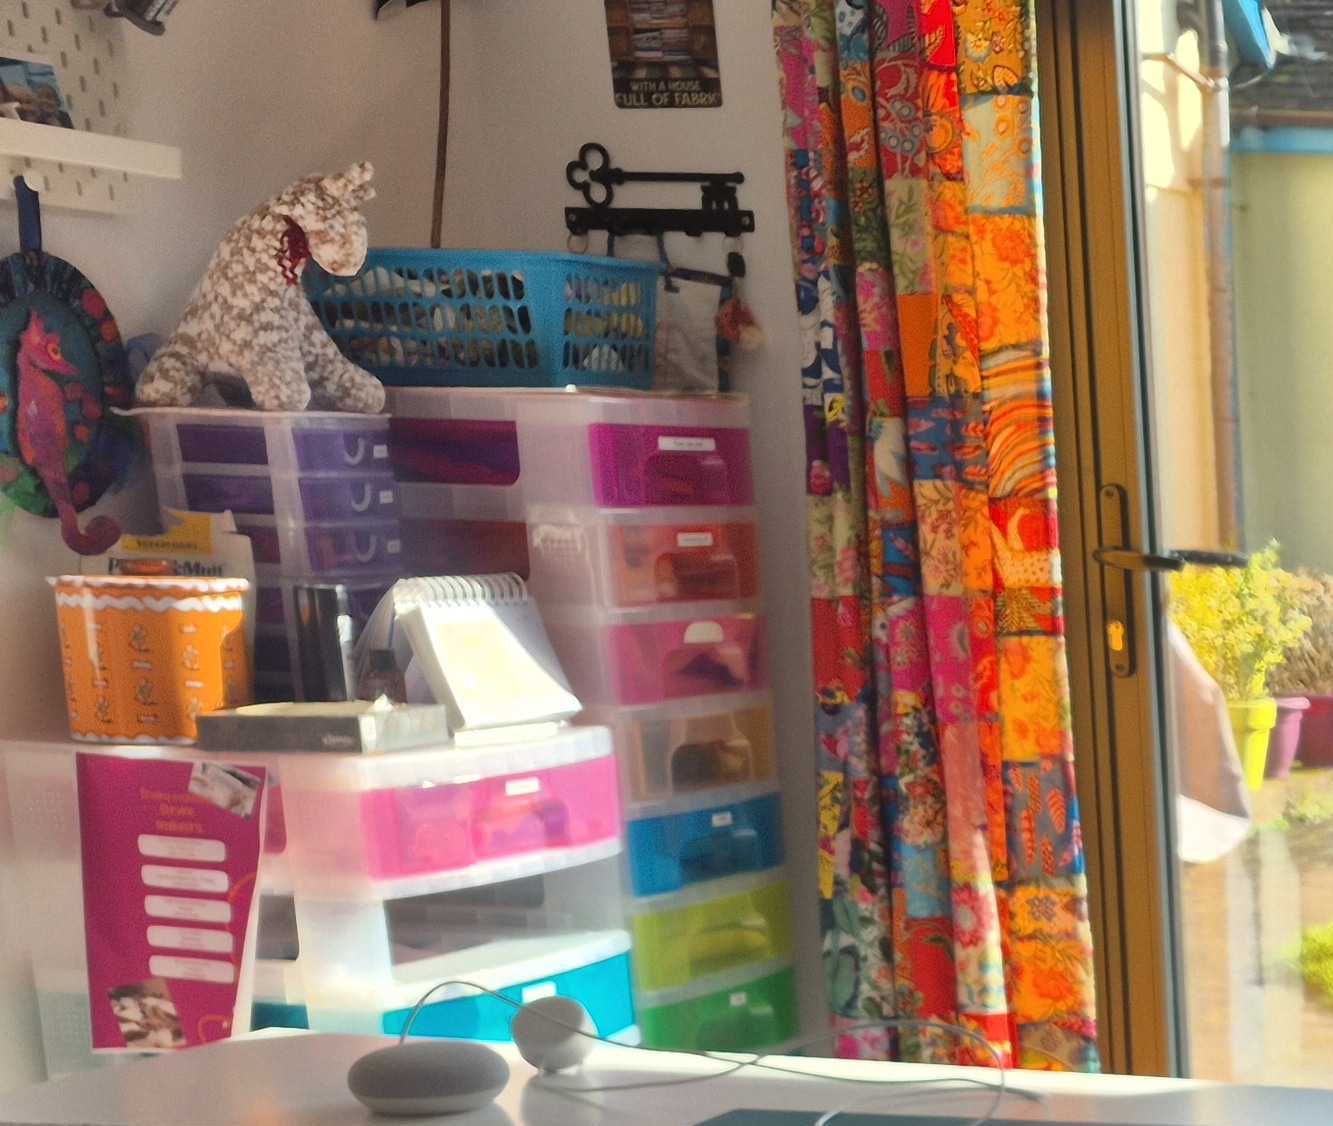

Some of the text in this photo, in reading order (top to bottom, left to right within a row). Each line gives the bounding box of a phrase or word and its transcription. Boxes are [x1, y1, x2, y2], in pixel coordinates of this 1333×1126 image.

[629, 80, 701, 91] WITH A HOUSE
[651, 92, 671, 106] OF
